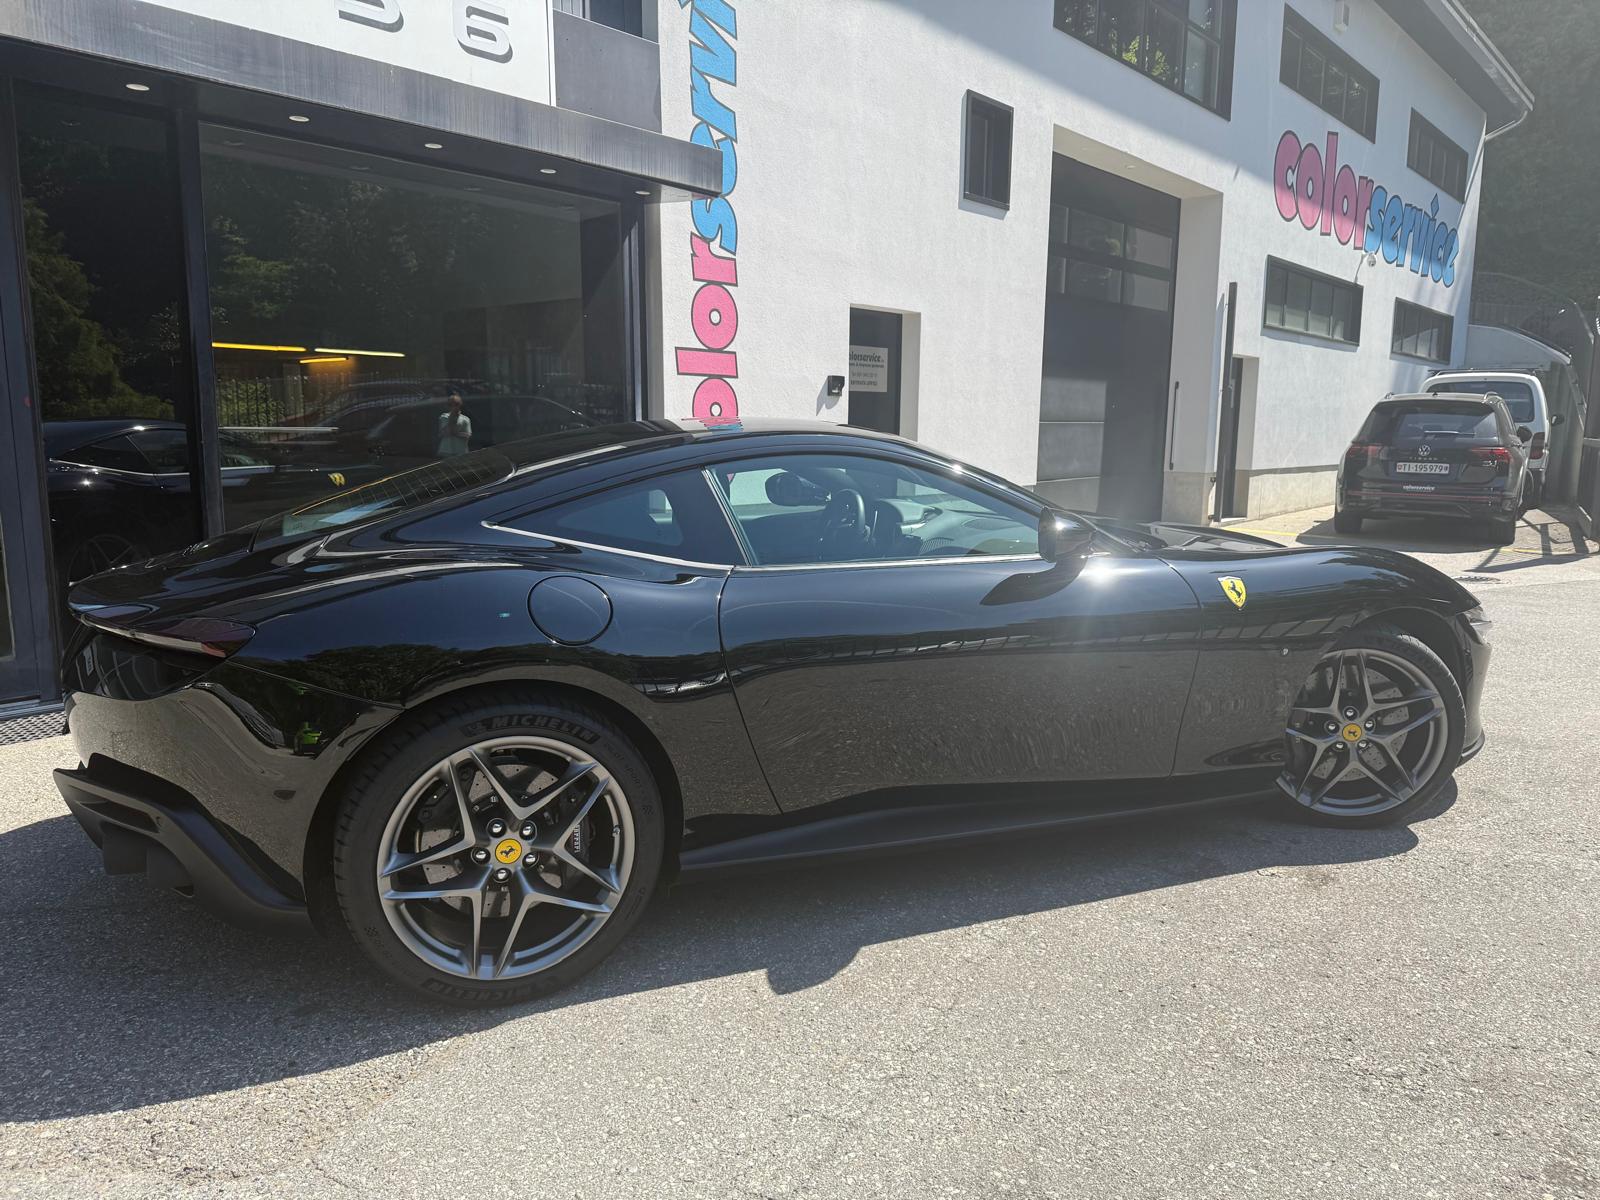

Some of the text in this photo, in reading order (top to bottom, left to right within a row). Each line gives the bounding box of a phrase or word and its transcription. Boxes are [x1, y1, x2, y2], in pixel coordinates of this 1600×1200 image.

[334, 0, 512, 63] 6
[1273, 130, 1460, 288] colorservice
[492, 713, 594, 740] MICHELIN
